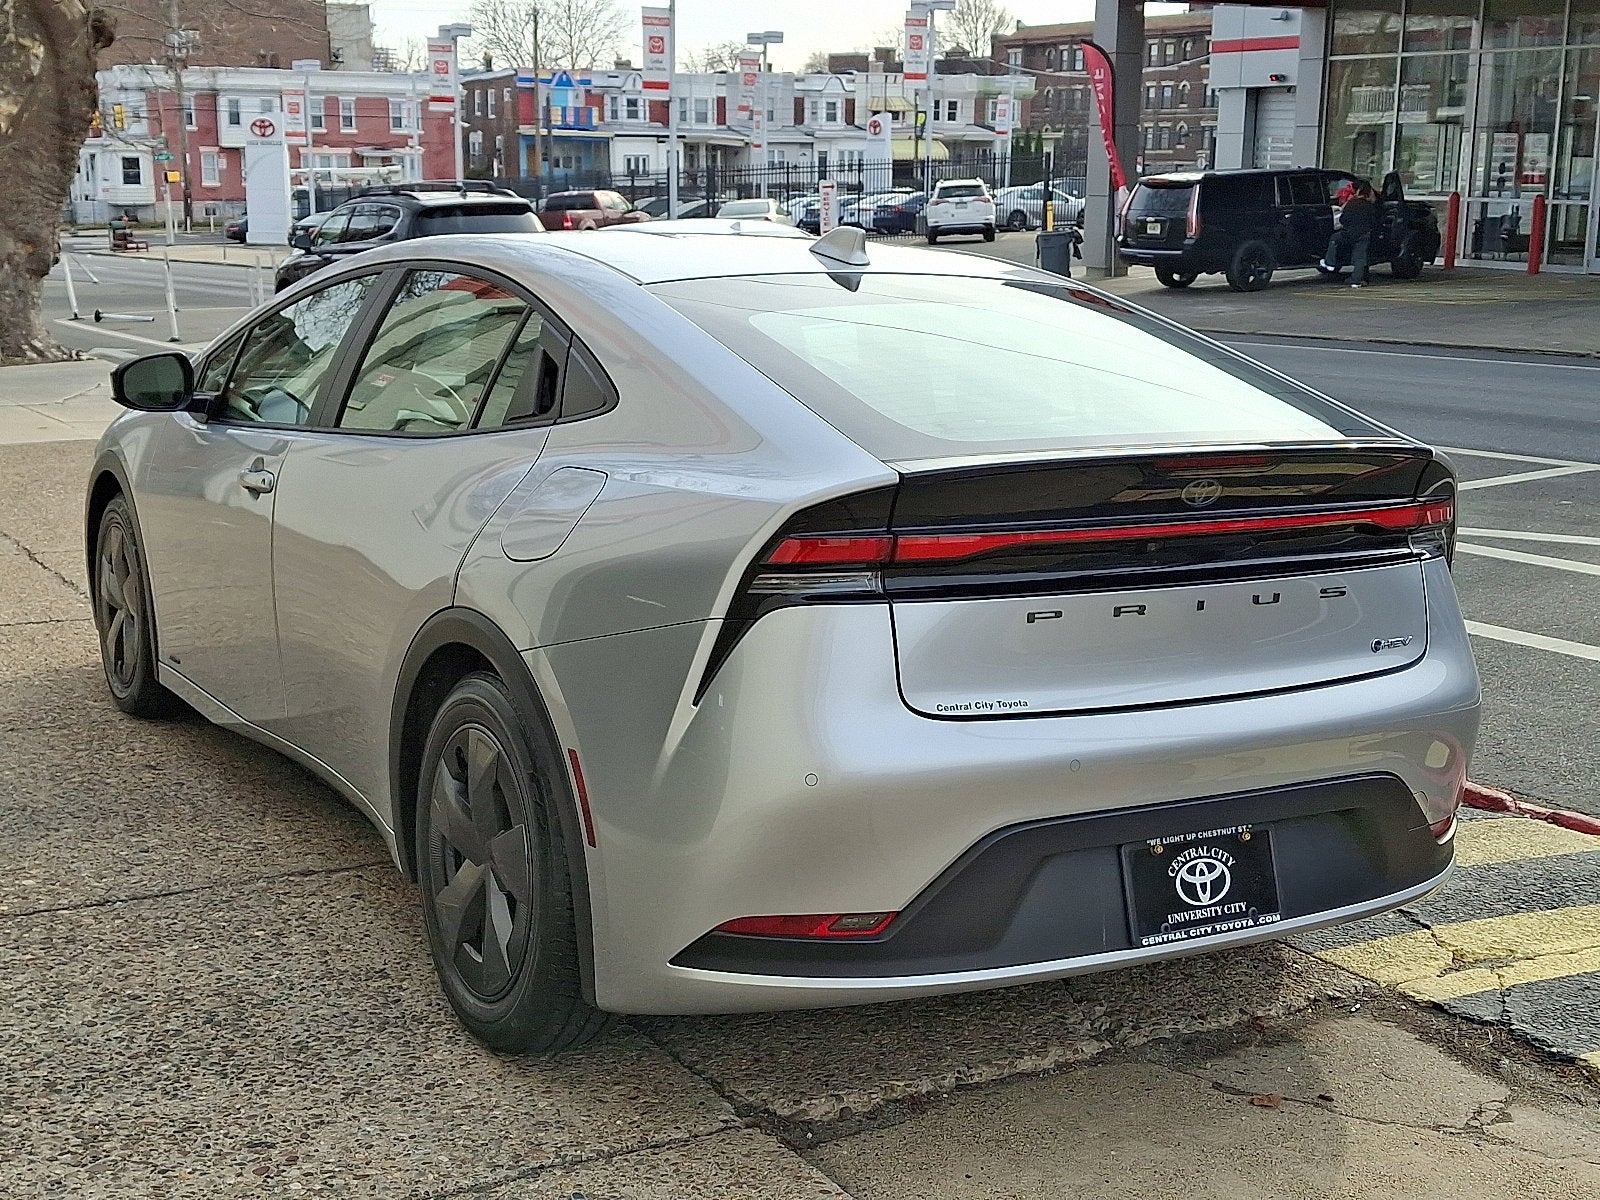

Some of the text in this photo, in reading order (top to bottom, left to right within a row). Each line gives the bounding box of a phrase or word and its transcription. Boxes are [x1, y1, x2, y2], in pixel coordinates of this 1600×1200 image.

[1026, 585, 1348, 624] PRIUS
[936, 699, 1028, 712] Central City Toyota
[1163, 834, 1184, 844] LIGHT
[1198, 827, 1236, 839] CHESTNUT
[1167, 845, 1236, 877] CENTRAL CITY
[1168, 902, 1247, 925] UNIVERSITY CITY
[1142, 914, 1281, 946] CENTRAL CITY TOYOTA .COM
